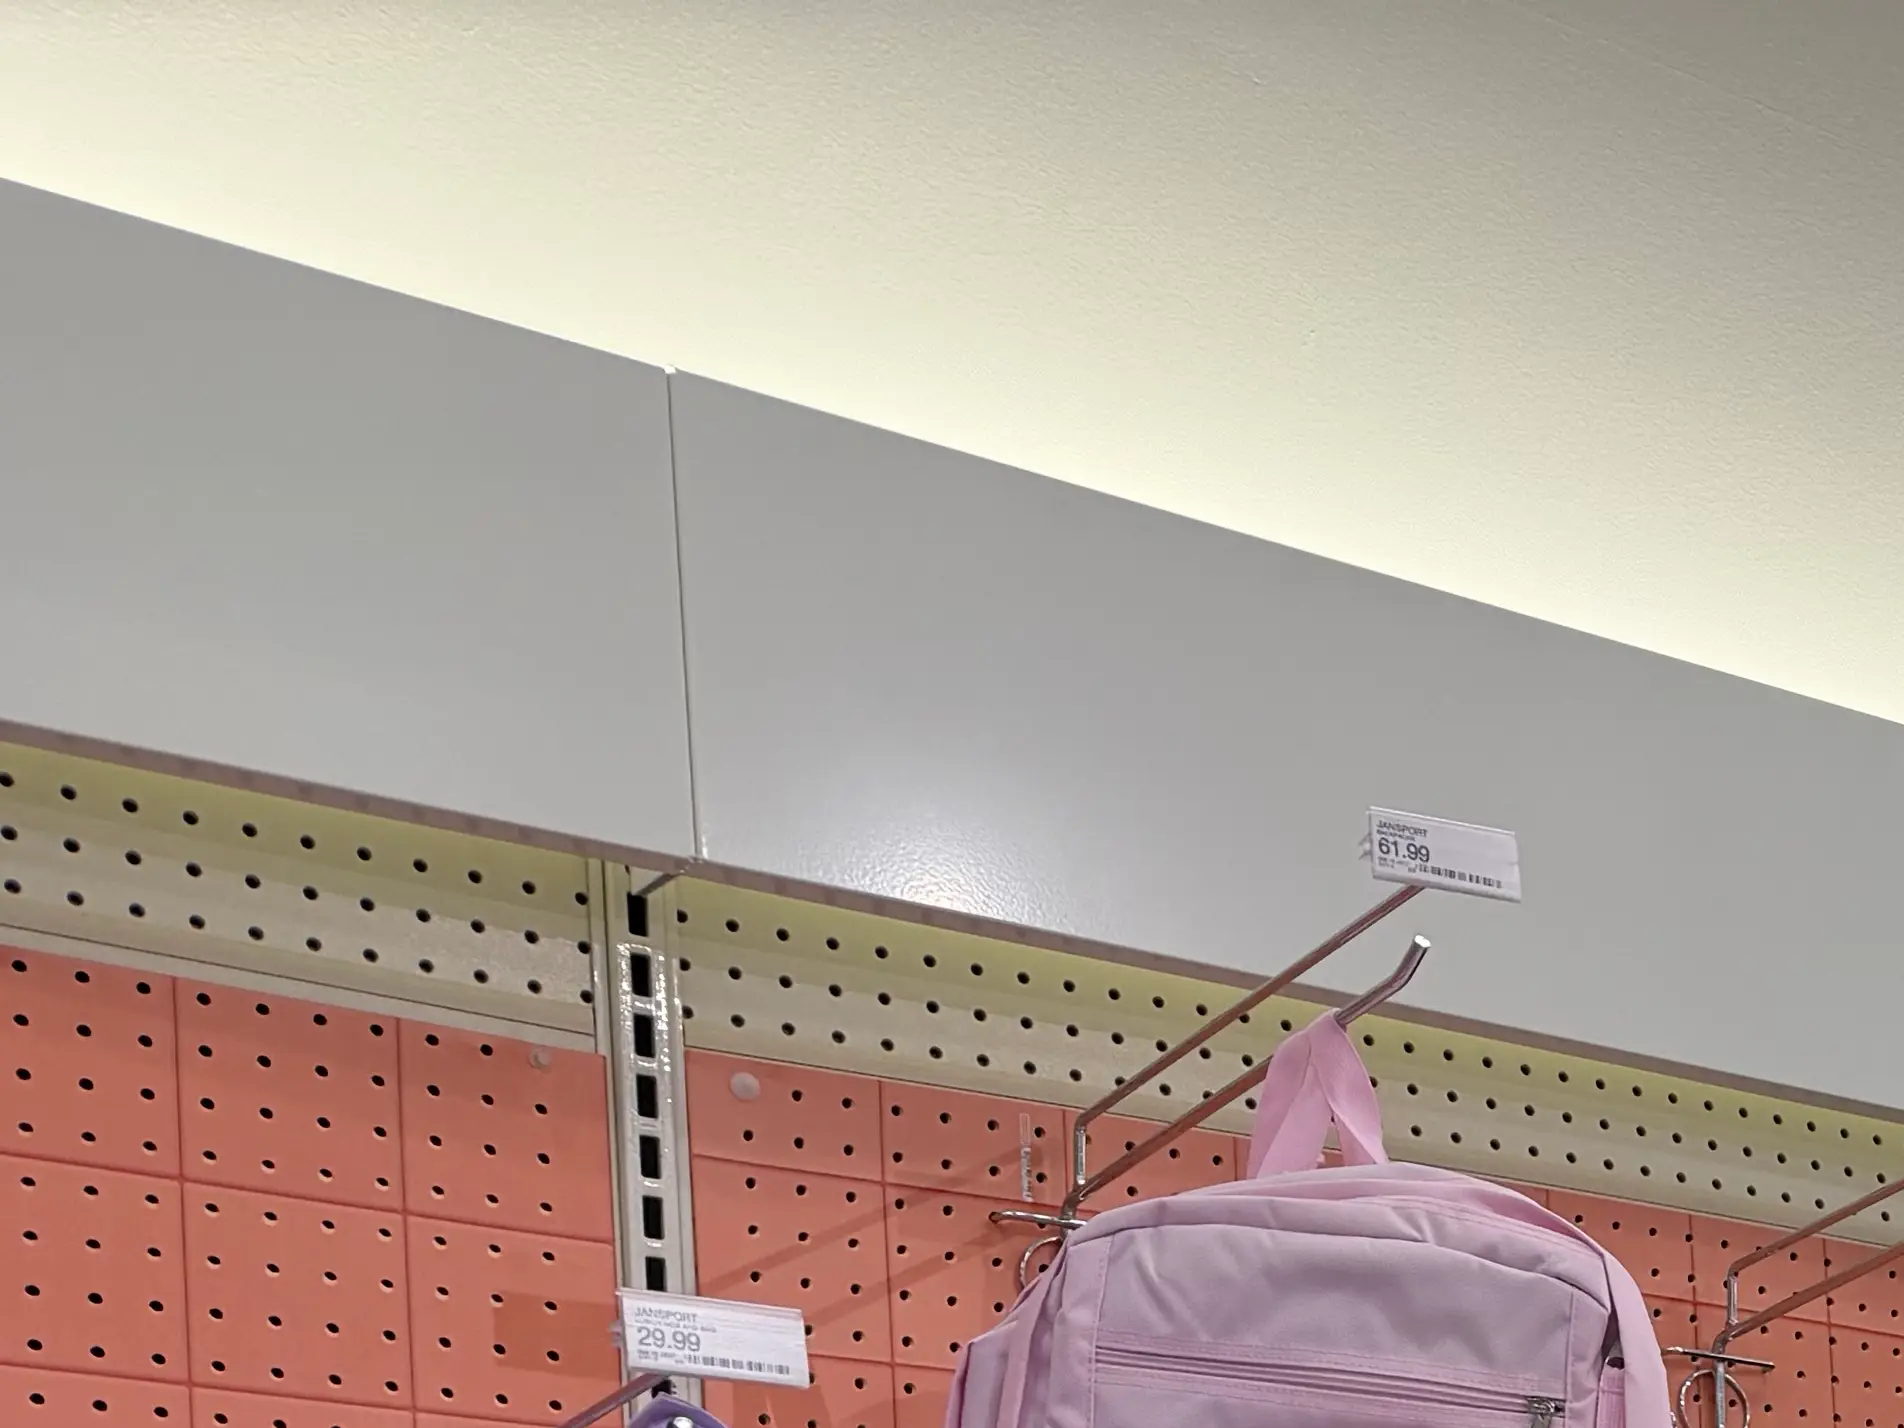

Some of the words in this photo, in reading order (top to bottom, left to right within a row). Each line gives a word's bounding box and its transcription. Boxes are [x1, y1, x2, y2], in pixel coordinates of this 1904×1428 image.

[1376, 819, 1428, 838] JANSPORT
[1378, 837, 1430, 863] 61.99
[635, 1307, 698, 1323] JANSPORT
[637, 1326, 701, 1352] 29.99
